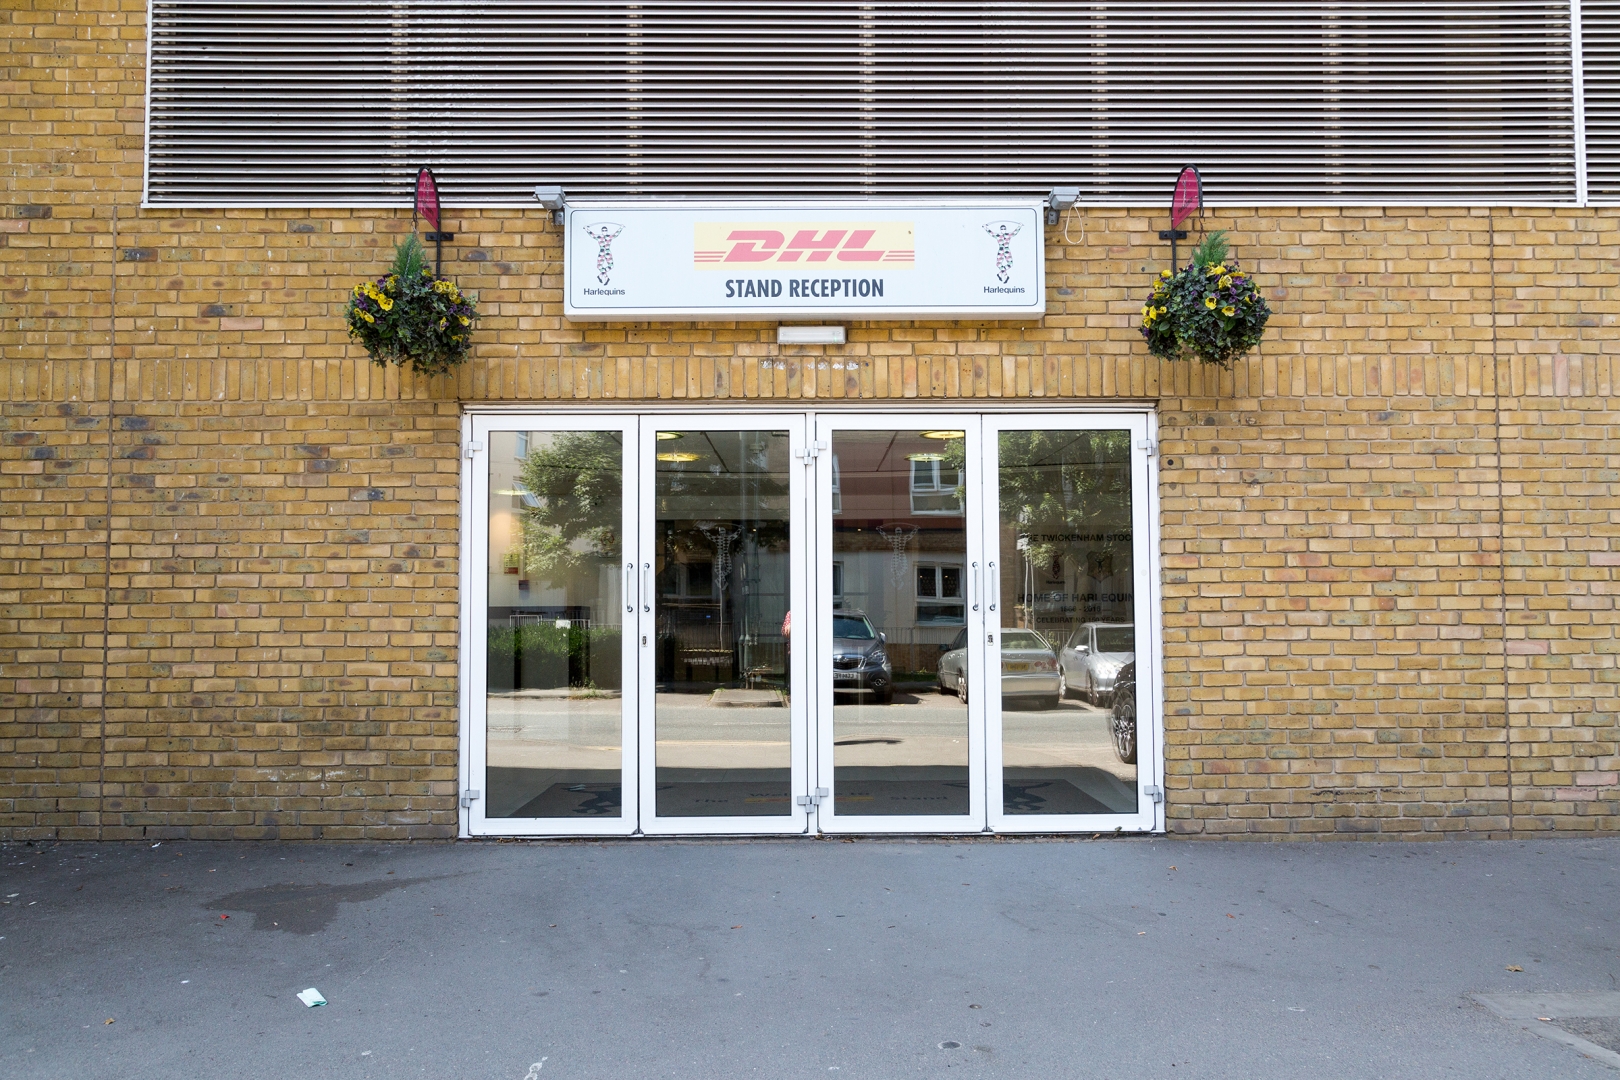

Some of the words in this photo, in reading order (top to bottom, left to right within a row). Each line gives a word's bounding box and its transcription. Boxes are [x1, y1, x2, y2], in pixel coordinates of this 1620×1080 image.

[723, 230, 885, 262] DHL
[583, 287, 626, 296] Harlequins
[725, 279, 783, 298] STAND
[789, 279, 884, 298] RECEPTION
[983, 286, 1026, 294] Harlequins
[1041, 534, 1104, 542] TWICKENHAM
[1017, 593, 1051, 603] HOME
[1053, 593, 1069, 603] OF
